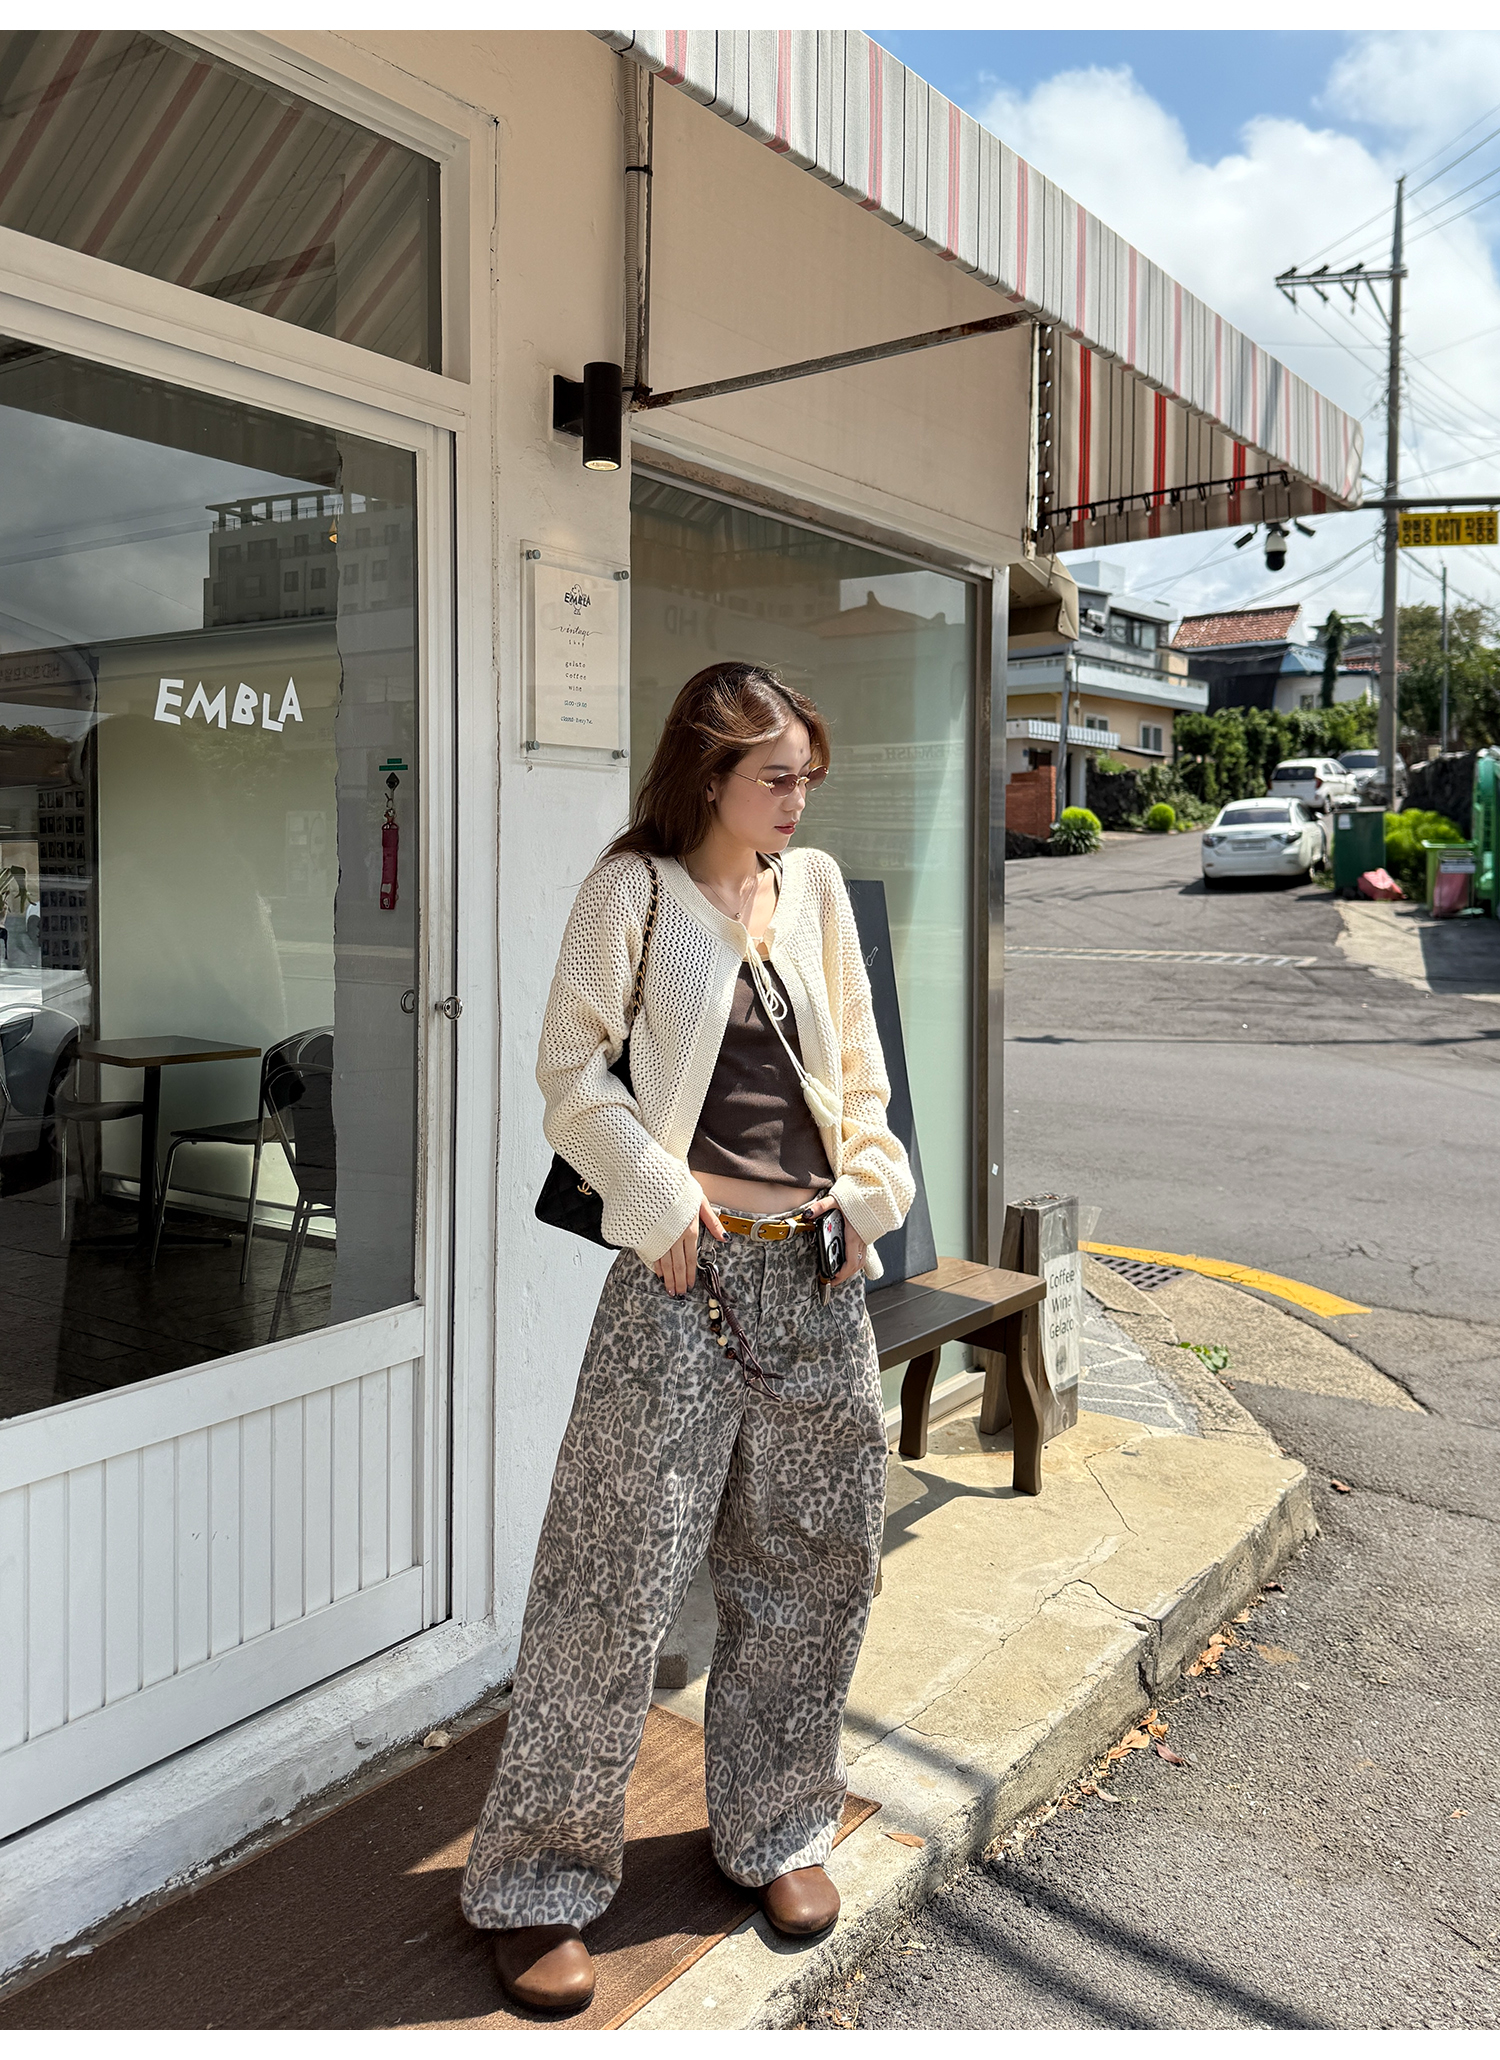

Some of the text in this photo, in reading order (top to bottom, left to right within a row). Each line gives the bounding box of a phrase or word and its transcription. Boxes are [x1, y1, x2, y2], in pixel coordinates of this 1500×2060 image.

[564, 592, 591, 607] EMBLA
[565, 660, 586, 668] gelato
[565, 672, 587, 681] coffee
[154, 676, 304, 732] EMBLA
[1049, 1268, 1075, 1290] Coffee
[1051, 1295, 1072, 1313] Wine
[1049, 1318, 1074, 1339] Gelato
